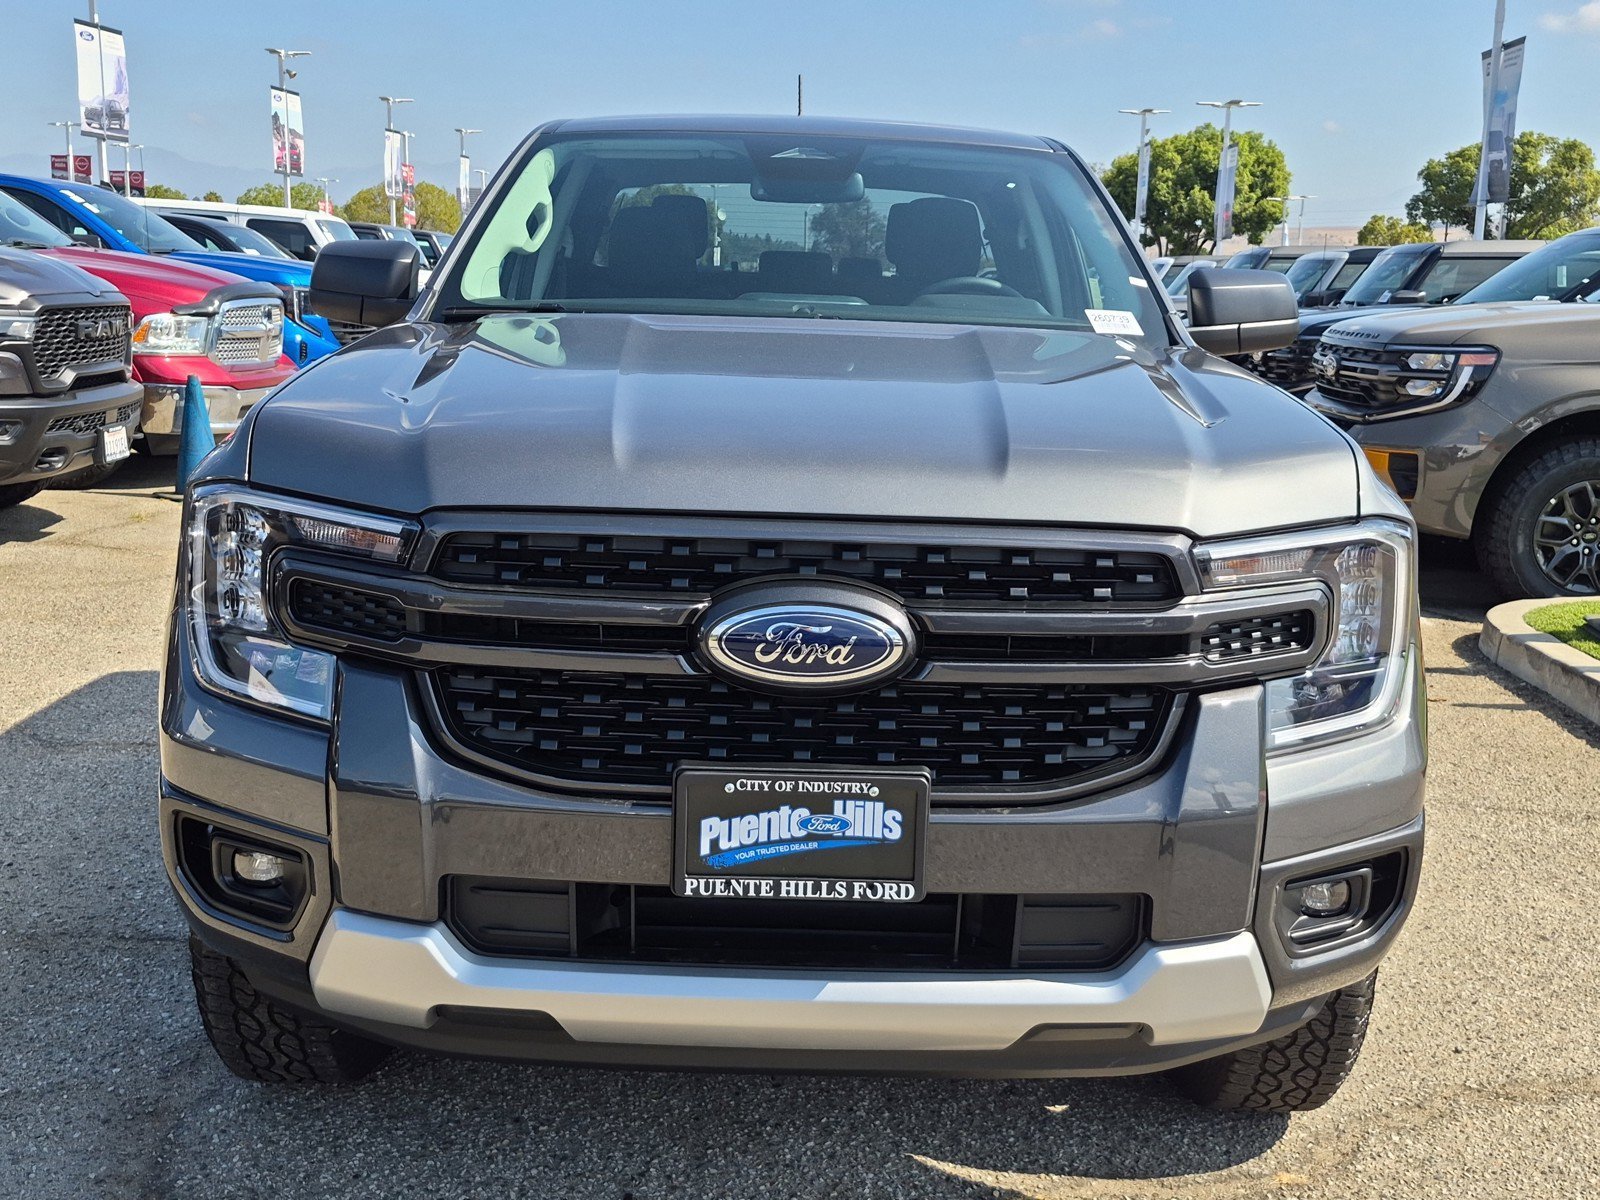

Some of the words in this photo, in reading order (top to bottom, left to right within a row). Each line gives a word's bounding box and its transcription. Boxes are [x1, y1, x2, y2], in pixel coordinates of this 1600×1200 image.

[78, 320, 122, 338] RAM
[754, 621, 858, 666] Ford
[736, 778, 772, 791] CITY
[774, 780, 794, 793] OF
[796, 781, 871, 794] INDUSTRY
[700, 804, 811, 856] Puente
[833, 800, 903, 840] Hills
[807, 816, 841, 832] Ford
[735, 850, 756, 861] YOUR
[756, 844, 790, 857] TRUSTED
[789, 842, 819, 852] DEALER
[684, 877, 774, 897] PUENTE
[779, 879, 847, 899] HILLS
[852, 881, 915, 901] FORD
